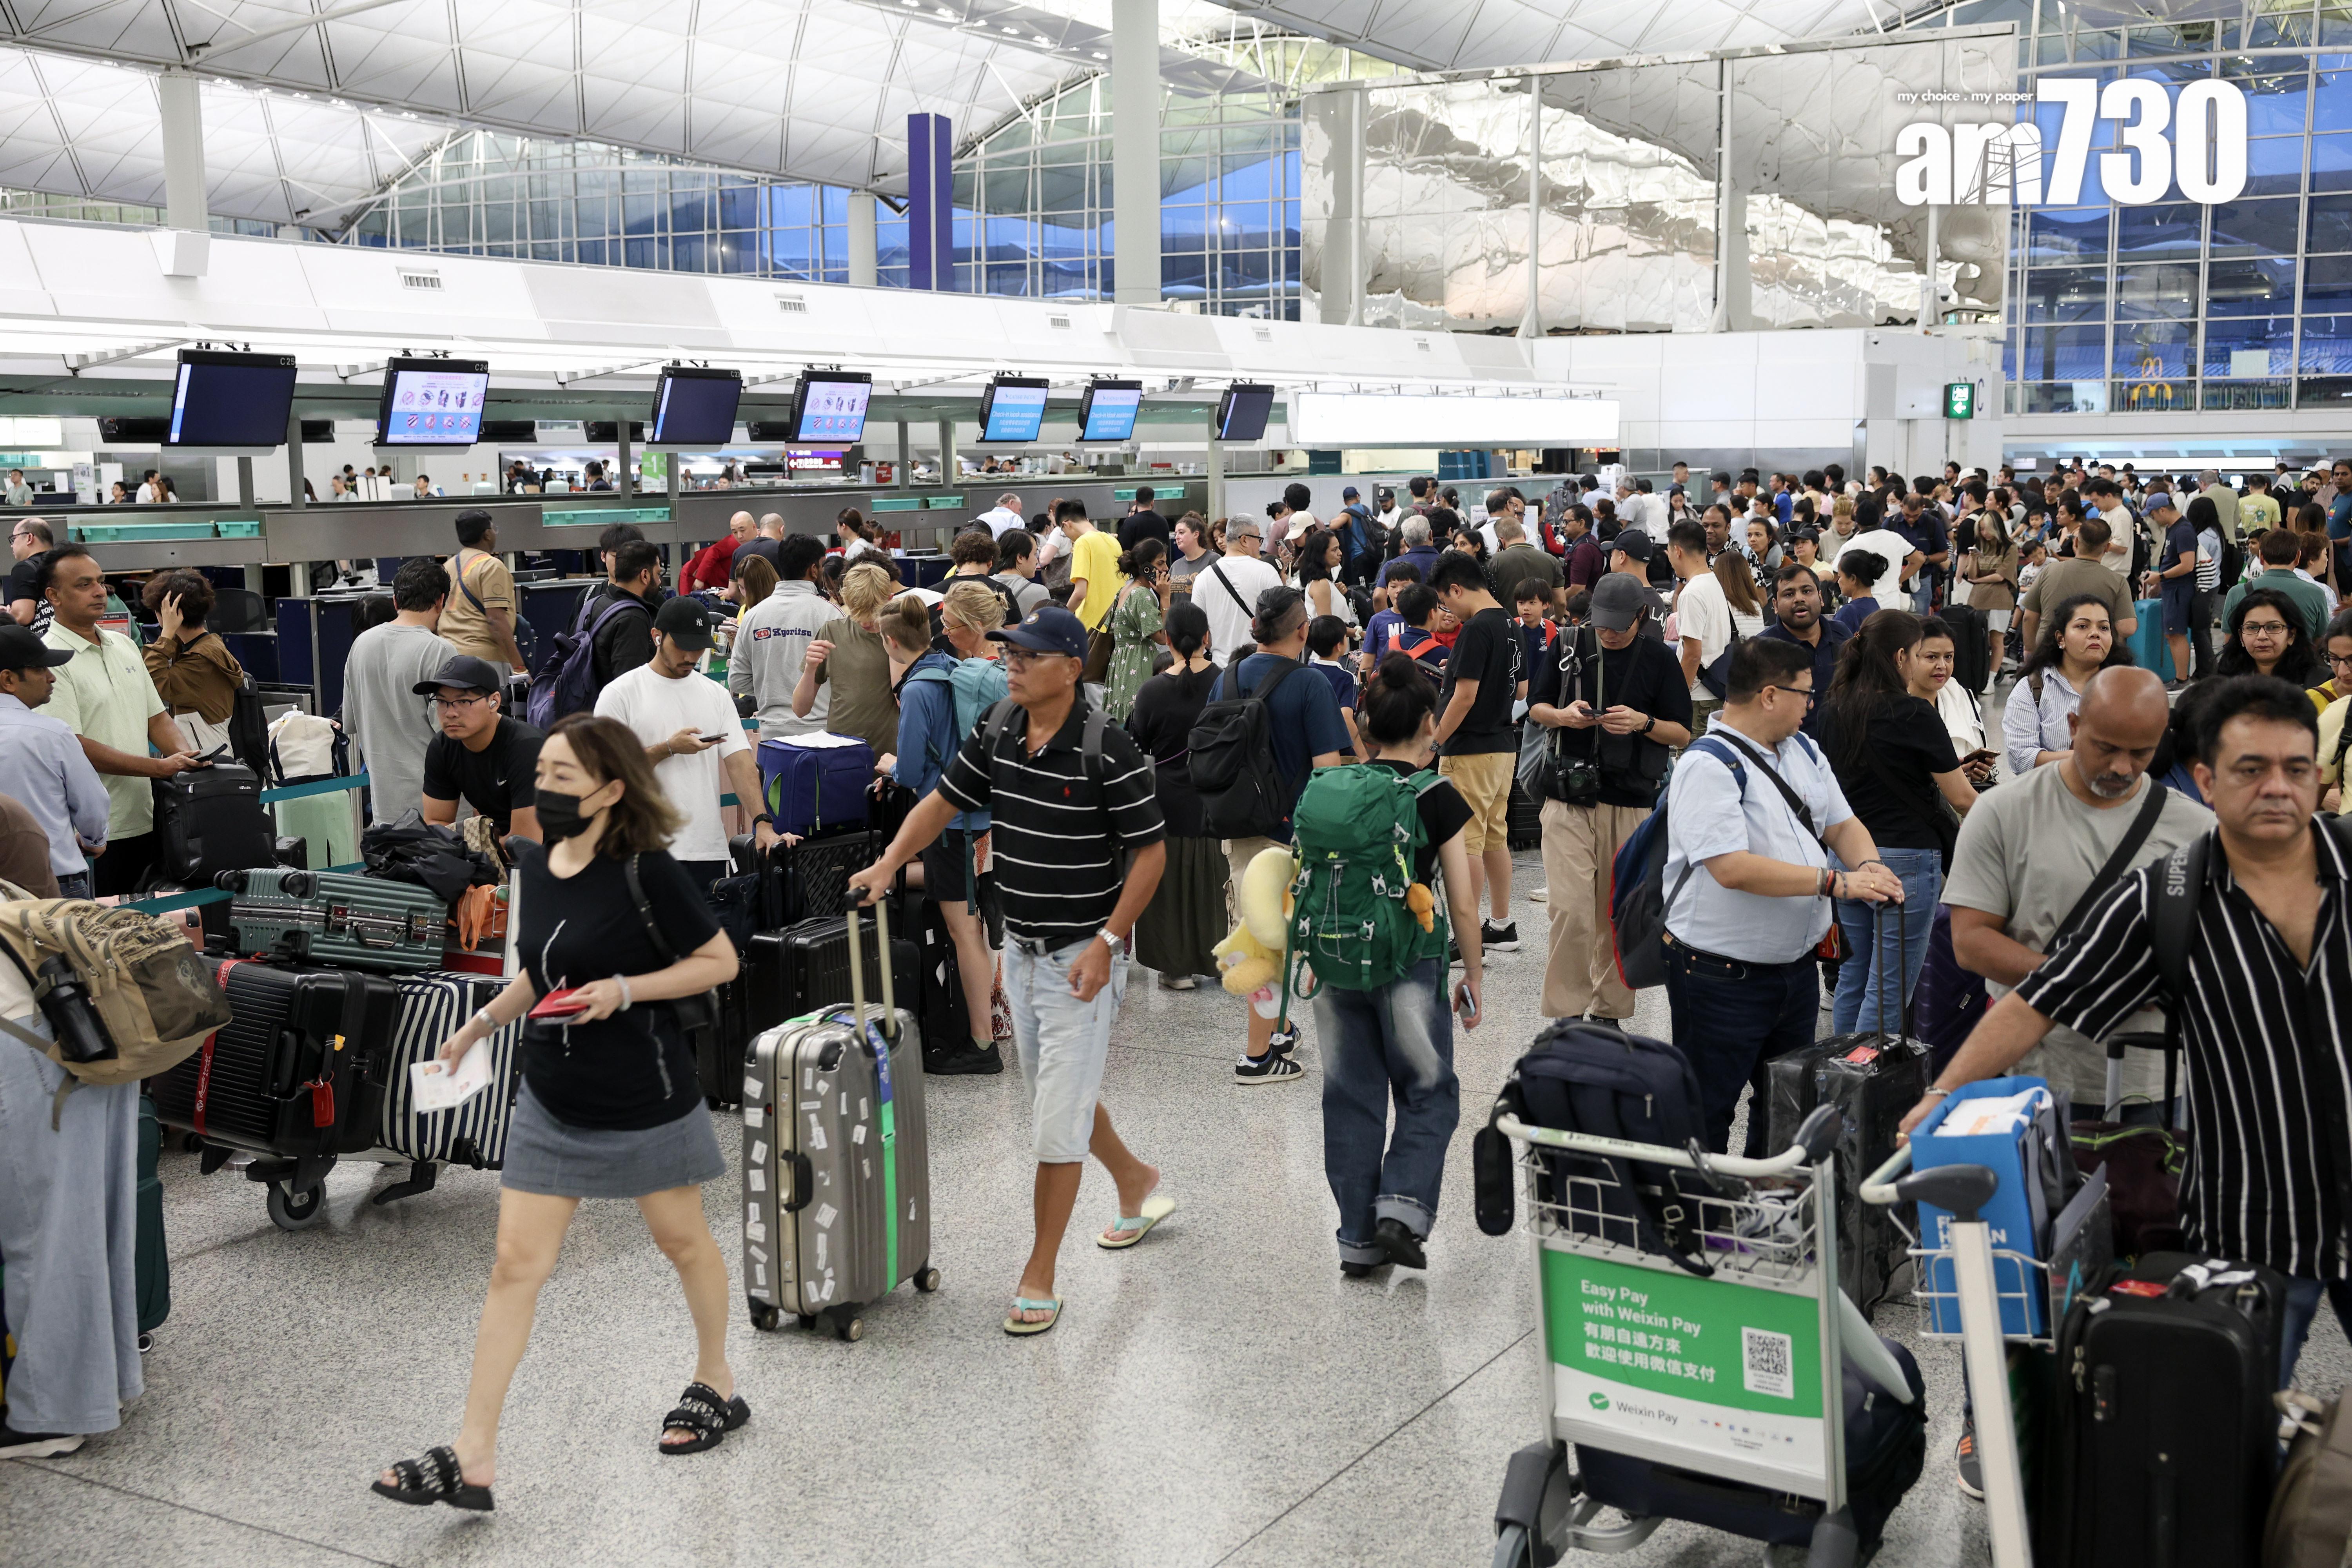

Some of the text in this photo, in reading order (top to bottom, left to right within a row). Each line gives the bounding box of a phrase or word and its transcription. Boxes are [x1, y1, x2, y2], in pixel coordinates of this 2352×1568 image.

[651, 455, 657, 473] 1
[696, 618, 703, 627] NY
[1581, 1279, 1648, 1307] Easy Pay
[1582, 1301, 1701, 1338] with Weixin Pay
[1617, 1401, 1678, 1425] Weixin Pay
